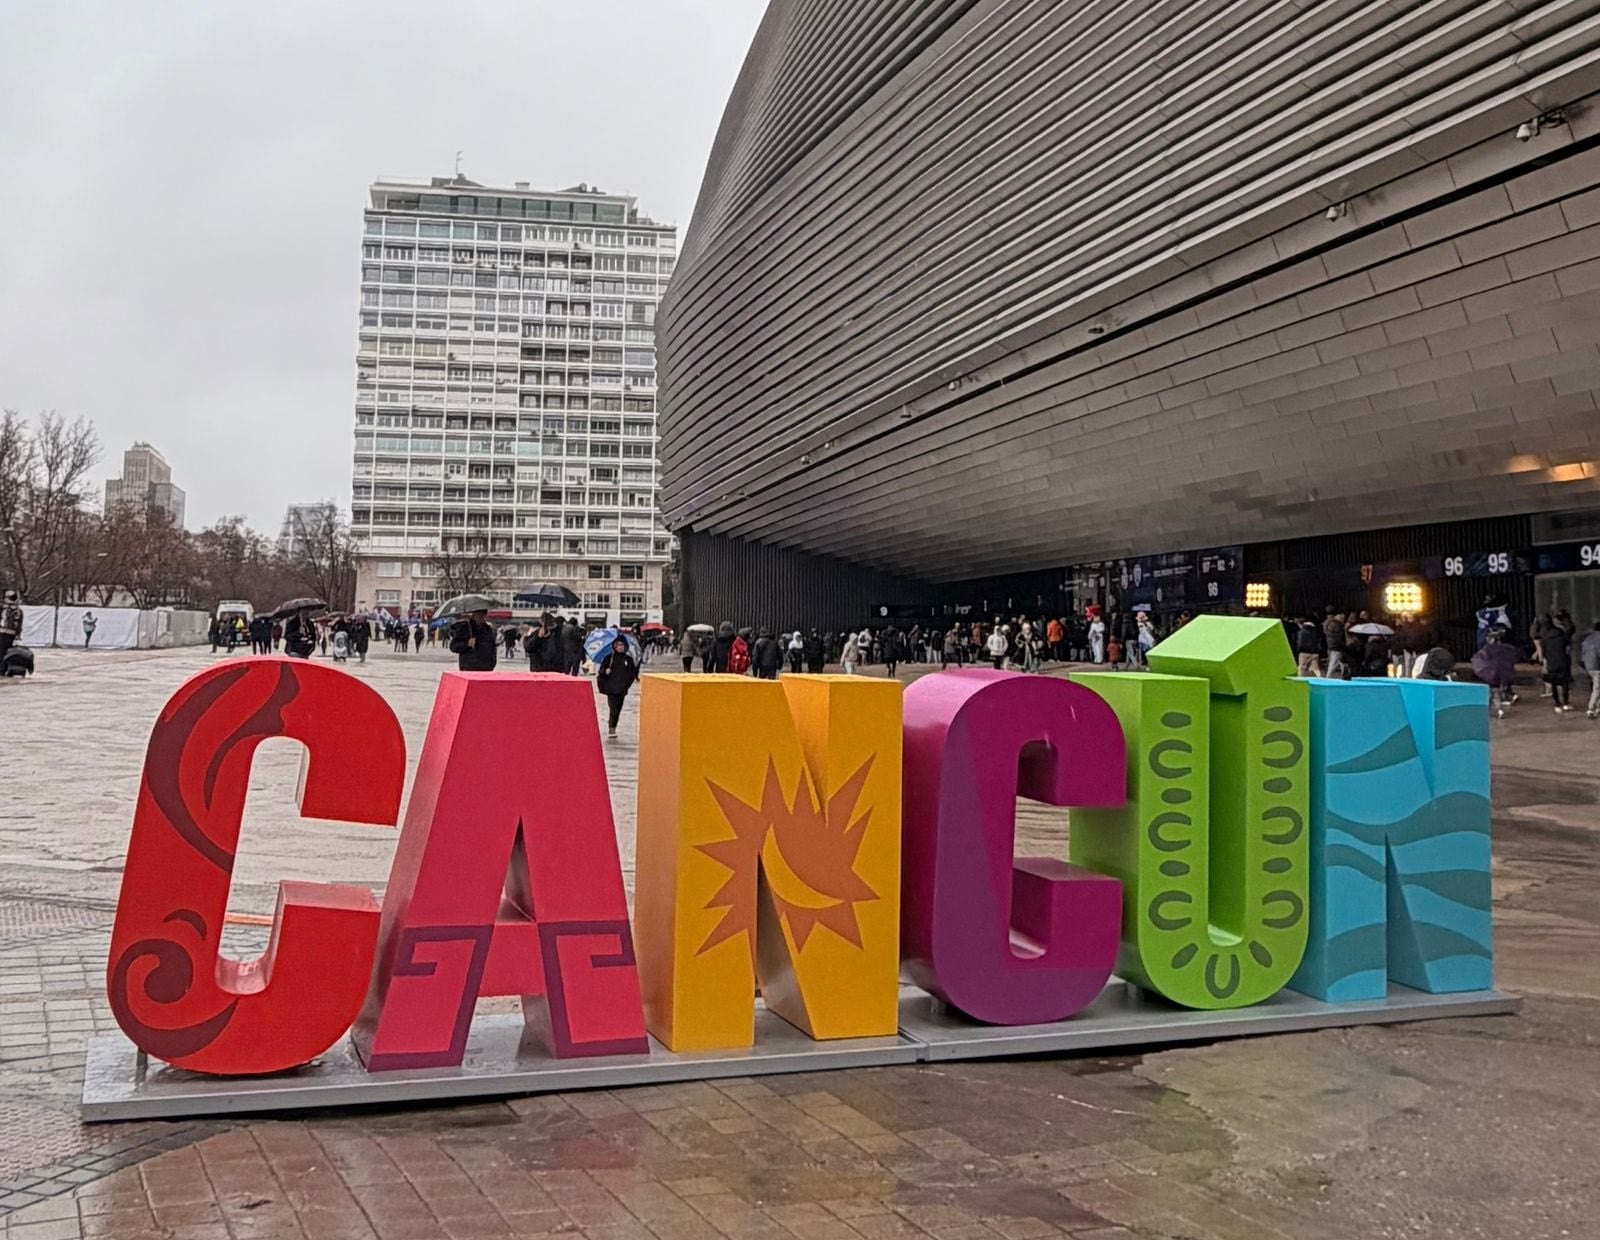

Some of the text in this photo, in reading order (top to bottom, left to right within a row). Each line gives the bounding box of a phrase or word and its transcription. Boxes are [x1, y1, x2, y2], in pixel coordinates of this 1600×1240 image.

[1488, 553, 1508, 573] 95
[1580, 544, 1600, 566] 94
[1361, 564, 1373, 584] 97
[1444, 557, 1464, 576] 96
[107, 614, 1493, 1076] CANCÚN
